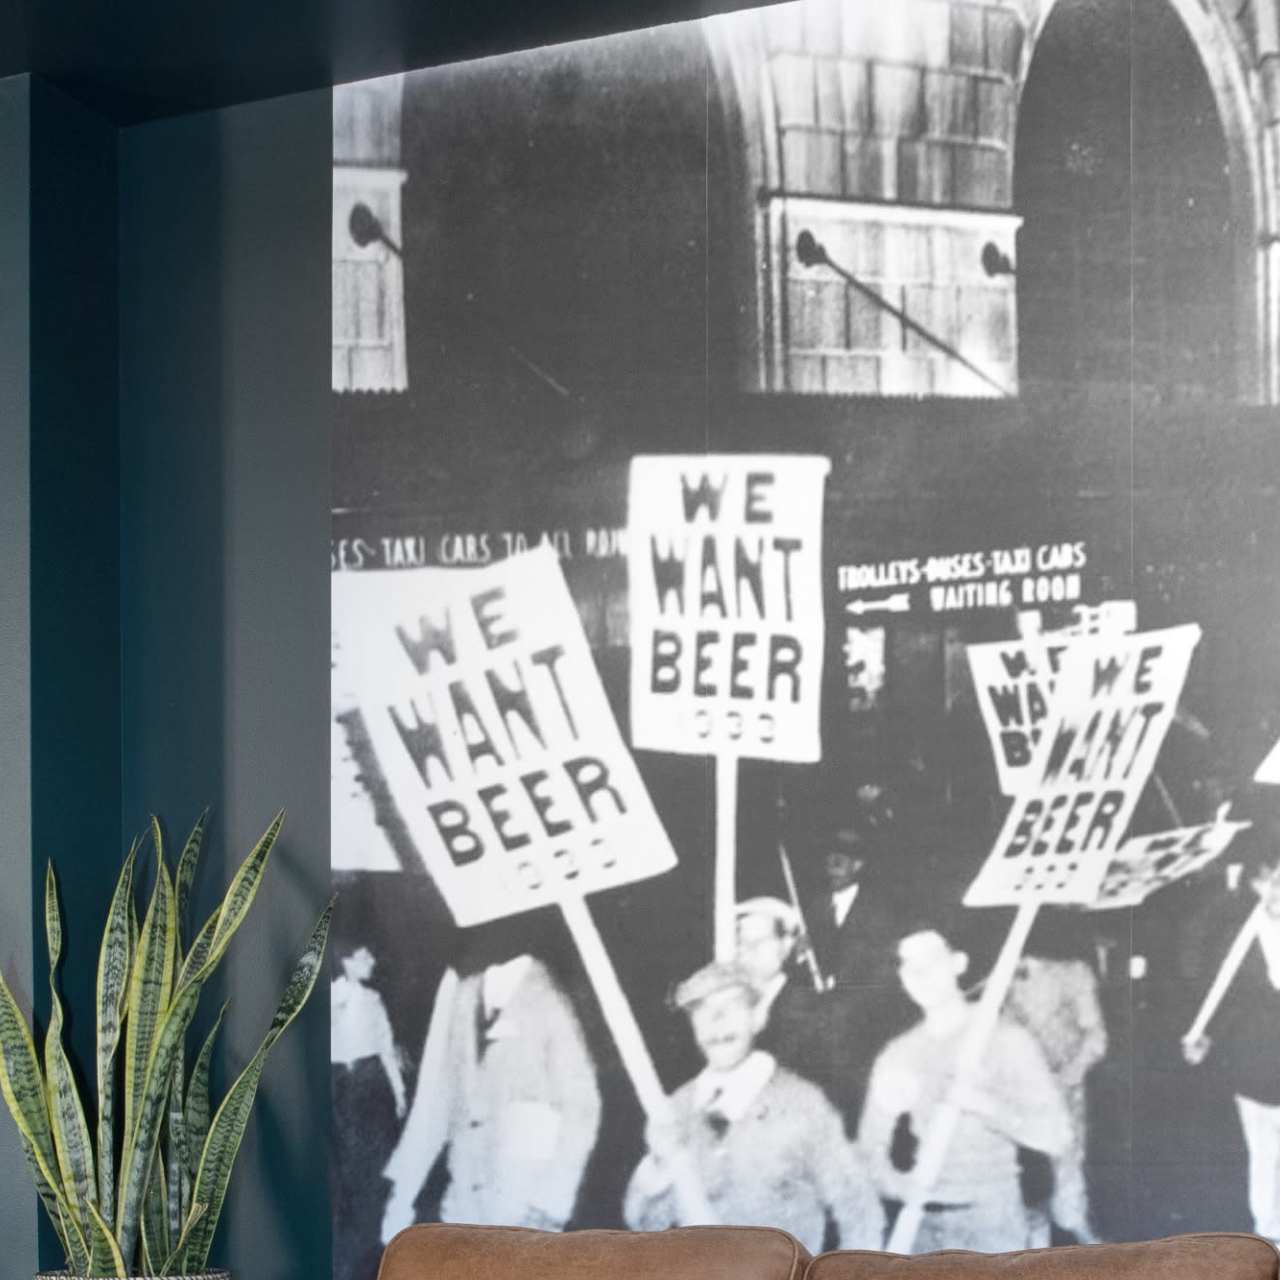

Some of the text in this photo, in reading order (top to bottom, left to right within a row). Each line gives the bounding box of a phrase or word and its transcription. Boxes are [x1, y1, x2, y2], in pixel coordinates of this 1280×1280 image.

[680, 471, 775, 524] WE
[440, 532, 491, 565] CABS
[650, 532, 802, 622] WANT
[1021, 574, 1081, 602] ROOM
[395, 586, 517, 675] WE
[651, 630, 802, 704] BEER
[1091, 645, 1163, 698] WE
[387, 644, 578, 790] WANT
[1041, 702, 1164, 785] WANT
[426, 755, 626, 868] BEER
[1003, 790, 1125, 858] BEER
